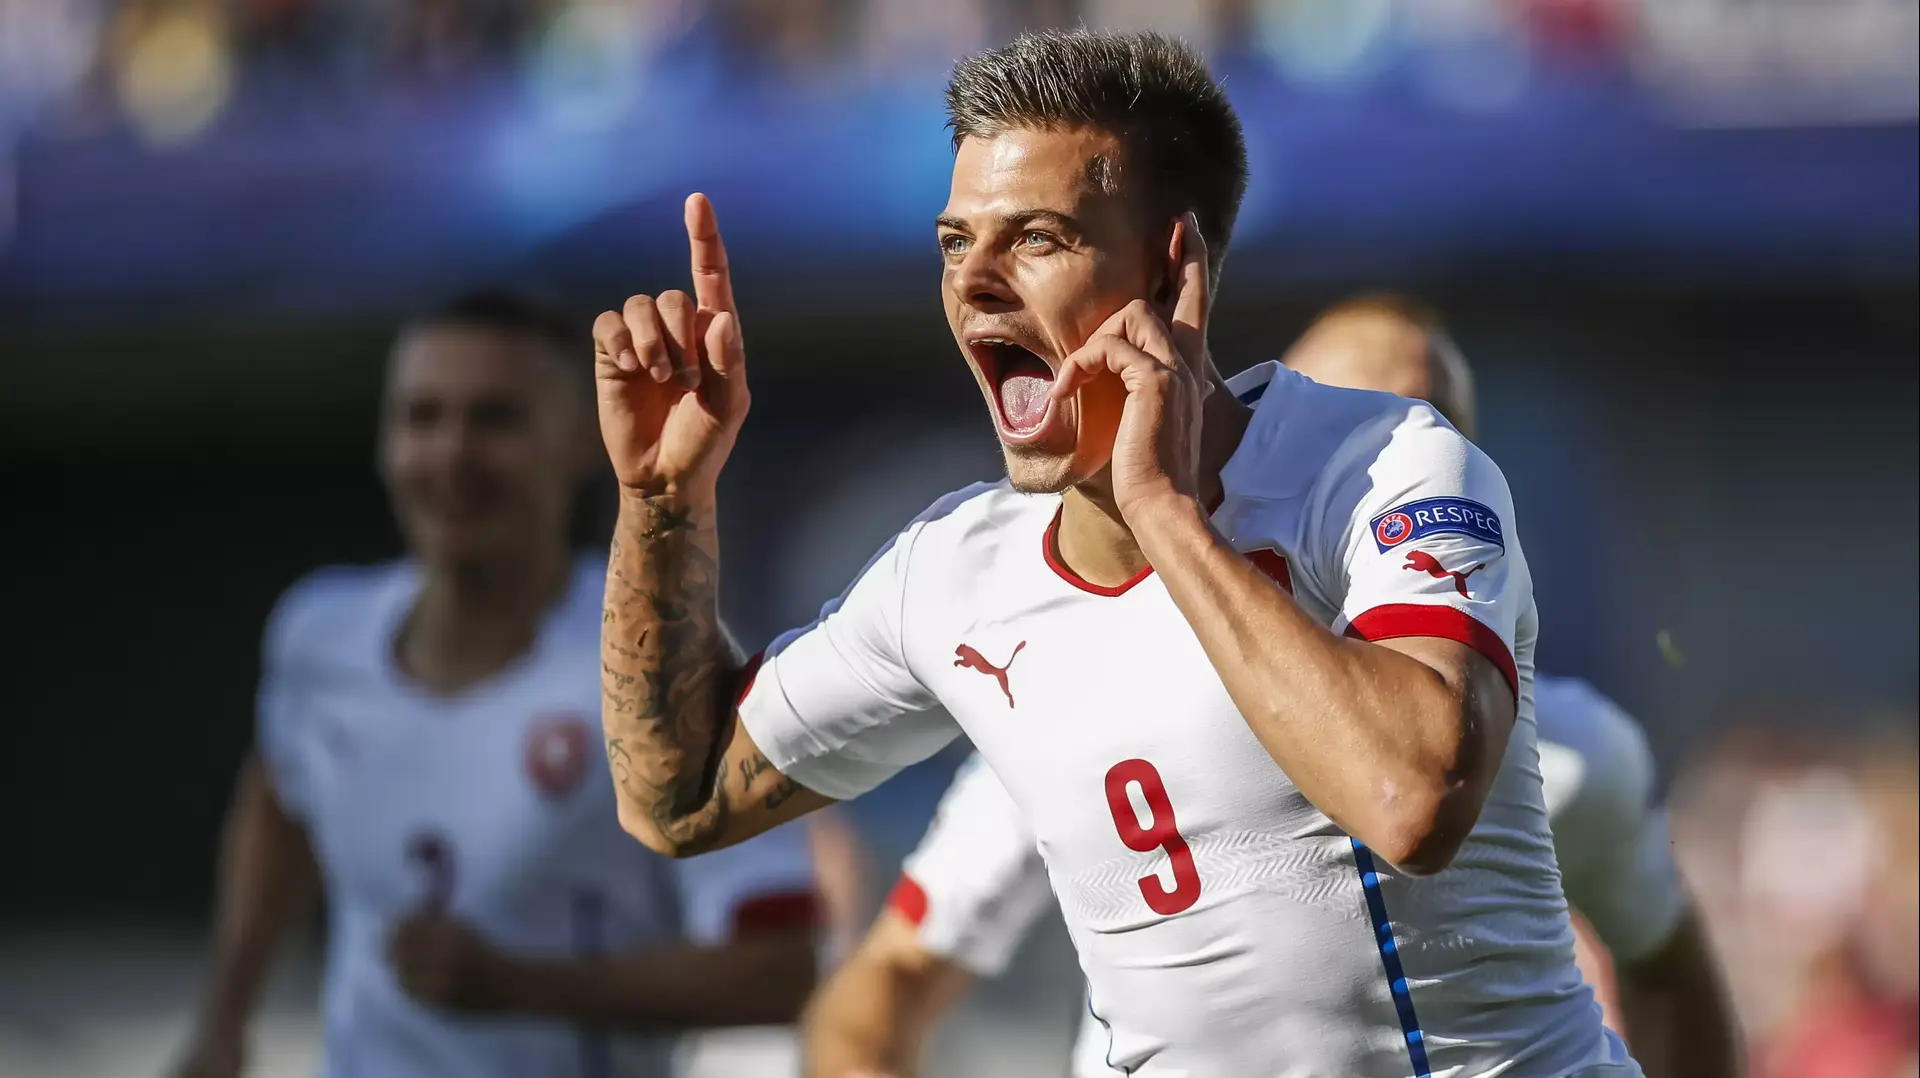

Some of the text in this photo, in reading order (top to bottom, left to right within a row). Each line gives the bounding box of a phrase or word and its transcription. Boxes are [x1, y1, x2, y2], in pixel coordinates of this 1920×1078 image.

[1380, 514, 1402, 528] UEFA
[1415, 506, 1501, 535] RESPEC
[1104, 758, 1201, 916] 9
